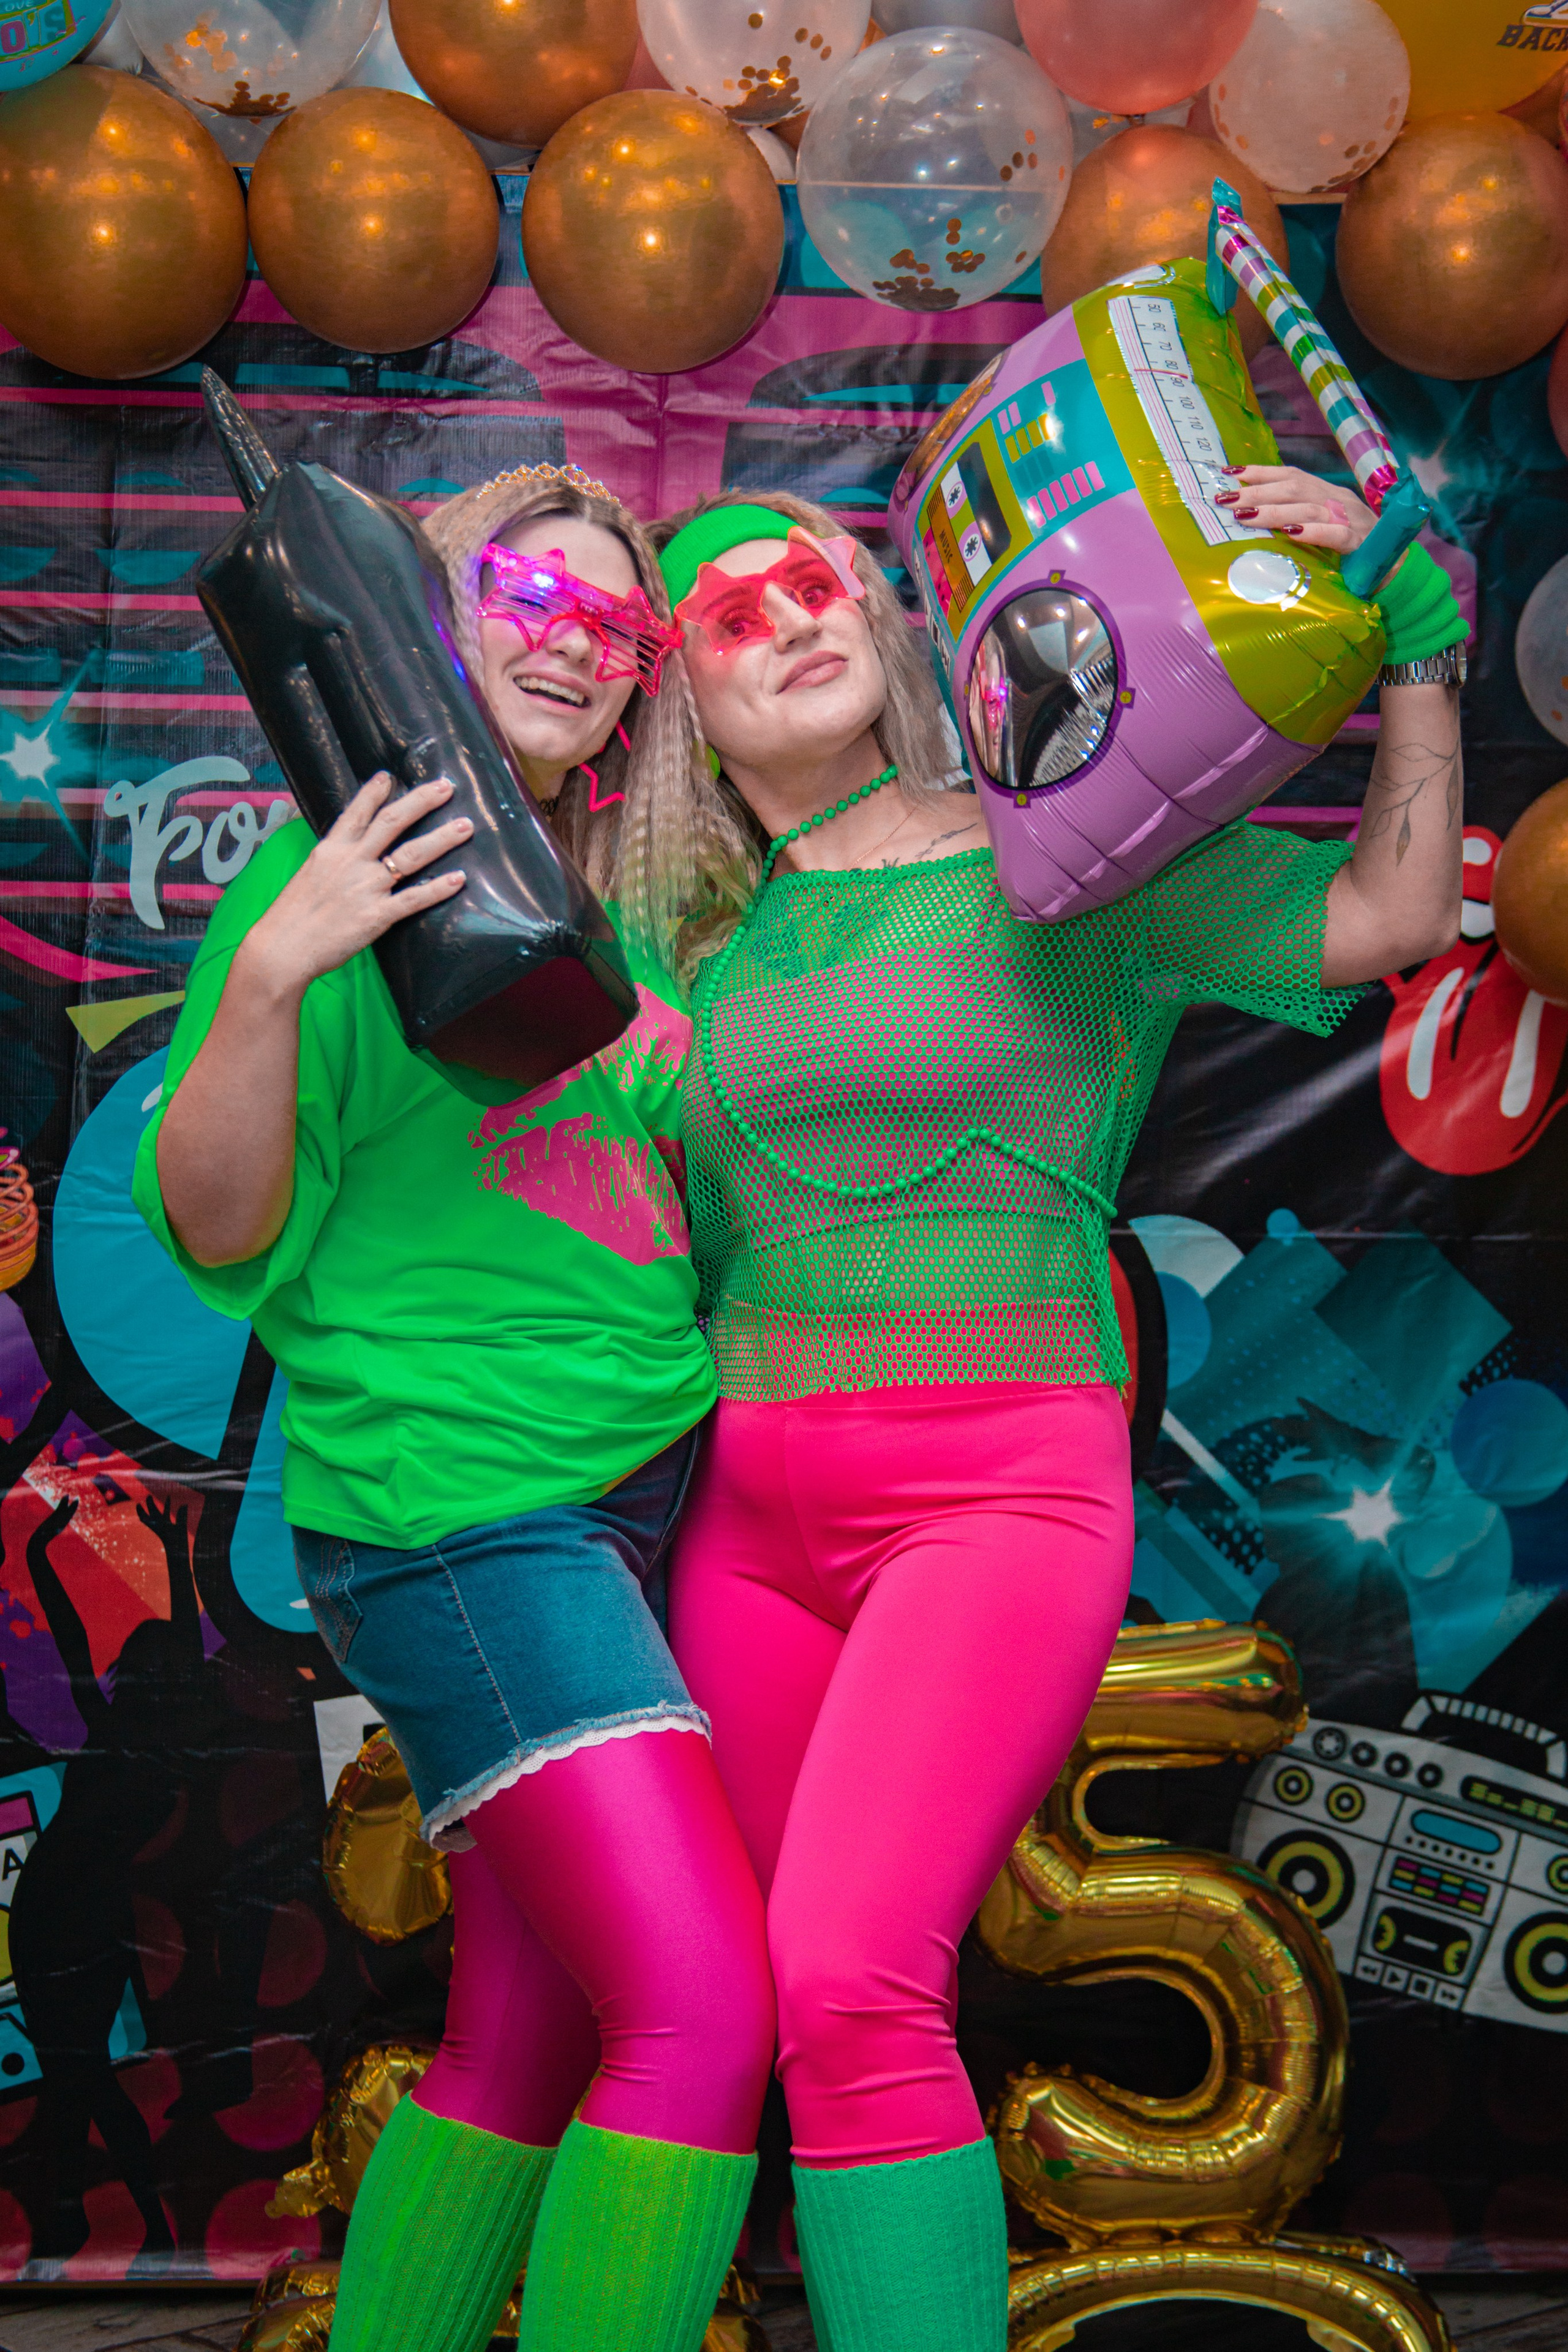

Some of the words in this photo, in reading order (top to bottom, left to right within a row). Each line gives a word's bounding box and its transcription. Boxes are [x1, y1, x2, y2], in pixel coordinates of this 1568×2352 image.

[1148, 304, 1161, 313] 50
[1159, 341, 1172, 351] 70
[1165, 360, 1178, 370] 80
[1170, 377, 1185, 387] 90
[1179, 396, 1194, 410] 100
[1188, 416, 1204, 430] 110
[1196, 437, 1212, 451] 120
[939, 529, 953, 564] MUSIC
